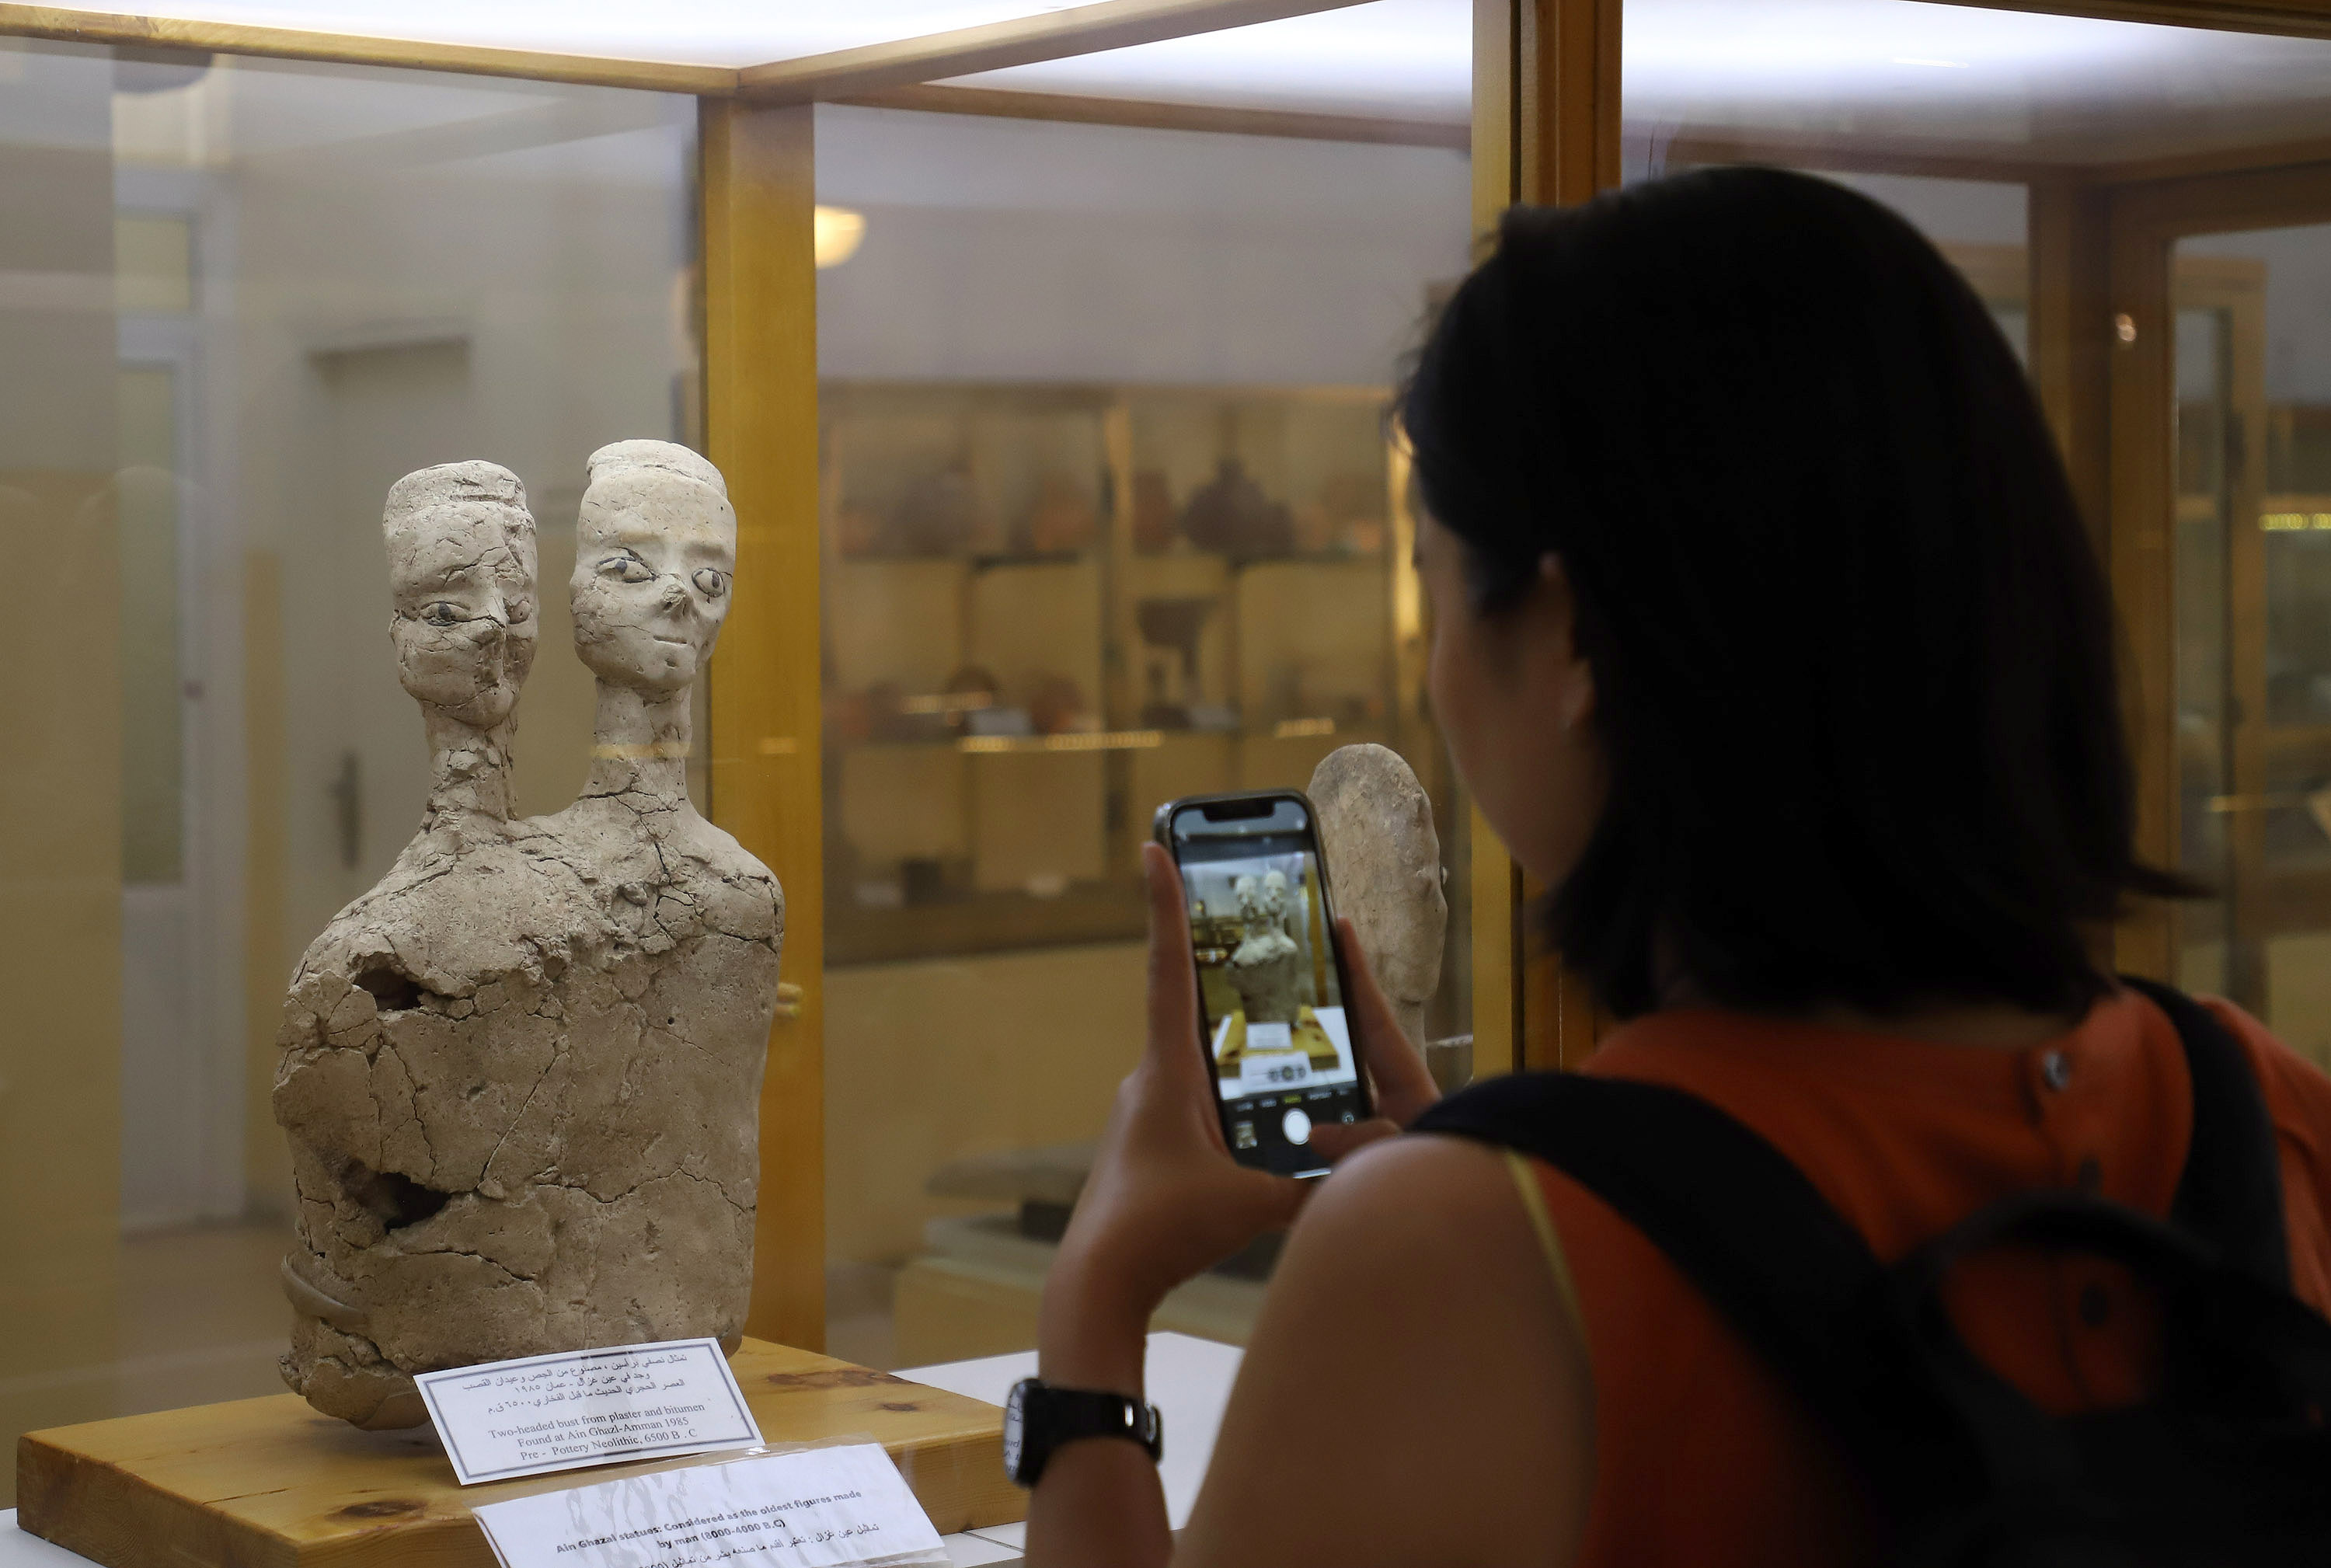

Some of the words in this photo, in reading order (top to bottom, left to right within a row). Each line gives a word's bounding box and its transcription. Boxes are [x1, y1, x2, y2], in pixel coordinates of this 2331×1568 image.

[528, 1368, 552, 1382] الجص
[557, 1369, 568, 1378] من
[570, 1364, 601, 1377] مصنوع
[620, 1371, 631, 1383] في
[633, 1371, 651, 1380] وجد
[462, 1378, 492, 1392] القصب
[577, 1375, 598, 1386] غزال
[601, 1375, 617, 1385] عين
[662, 1378, 685, 1391] العصر
[545, 1382, 566, 1392] عمان
[594, 1385, 622, 1397] الحديث
[625, 1382, 657, 1396] الحجري
[568, 1390, 583, 1401] قبل
[487, 1420, 556, 1439] Two-headed
[557, 1416, 580, 1429] bust
[581, 1414, 606, 1426] from
[608, 1409, 642, 1423] plaster
[645, 1406, 664, 1417] and
[664, 1403, 706, 1416] bitumen
[517, 1434, 552, 1448] Found
[555, 1433, 566, 1442] at
[568, 1430, 587, 1441] Ain
[589, 1420, 664, 1437] Ghazl-Amman
[664, 1416, 690, 1428] 1985
[520, 1451, 539, 1461] Pre
[551, 1443, 589, 1456] Pottery
[591, 1435, 643, 1450] Neolithic,
[644, 1432, 669, 1444] 6500
[556, 1543, 577, 1554] Ain
[578, 1533, 618, 1549] Ghazal
[618, 1525, 663, 1541] statues:
[664, 1513, 725, 1531] Considered
[726, 1512, 739, 1521] as
[740, 1508, 758, 1518] the
[760, 1501, 794, 1515] oldest
[793, 1495, 832, 1509] figures
[833, 1490, 862, 1502] made
[657, 1539, 673, 1549] by
[674, 1535, 699, 1546] man
[701, 1522, 761, 1542] (8000-4000
[761, 1518, 786, 1530] B.C)
[815, 1529, 834, 1542] غزال
[838, 1528, 853, 1539] عين
